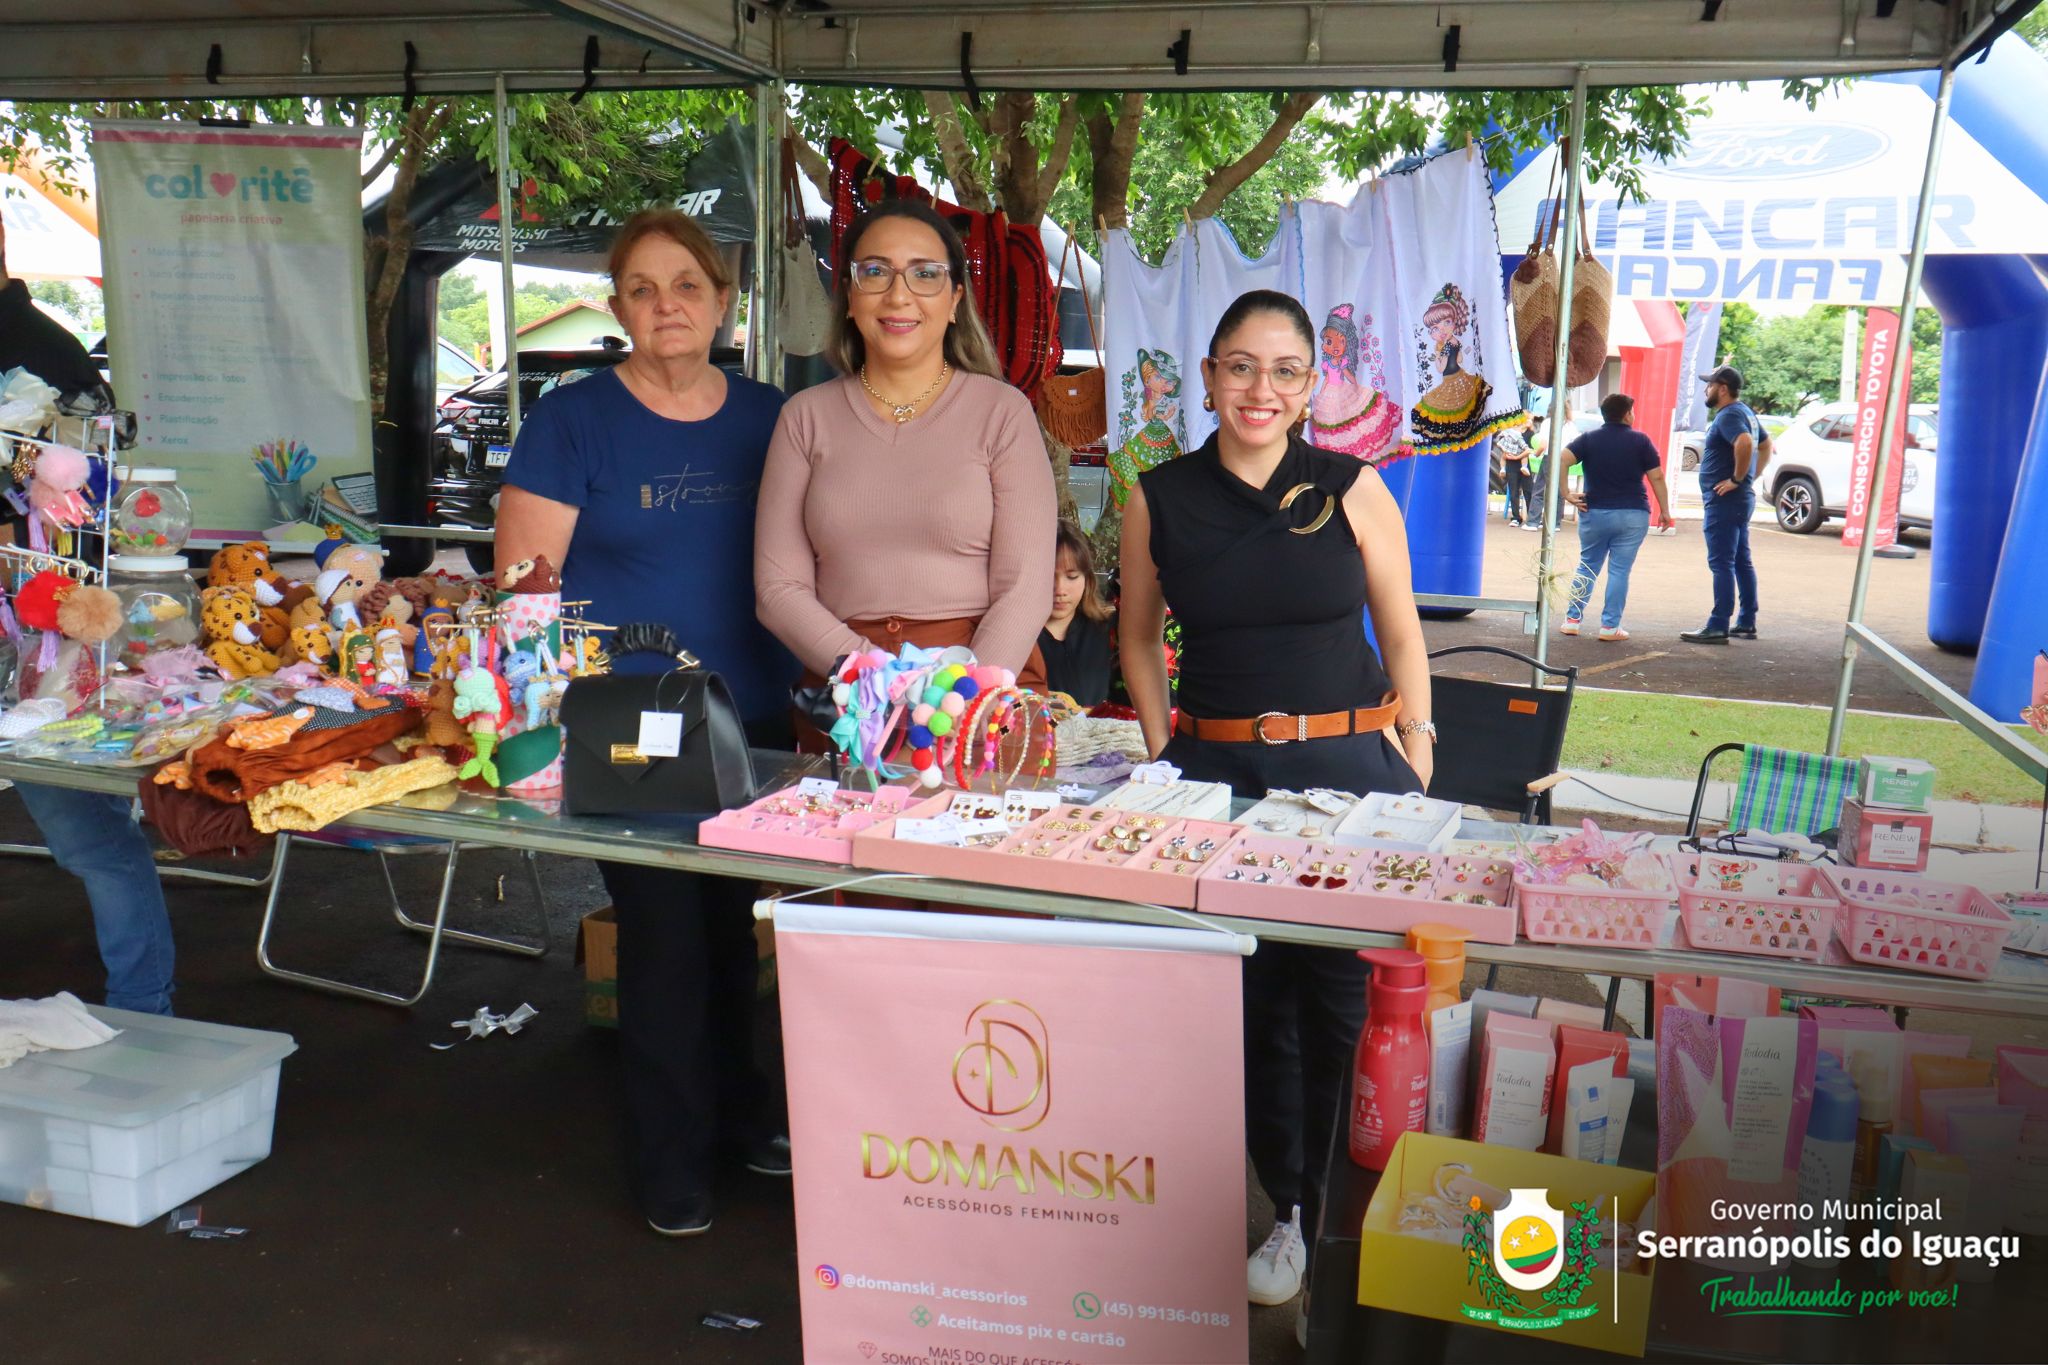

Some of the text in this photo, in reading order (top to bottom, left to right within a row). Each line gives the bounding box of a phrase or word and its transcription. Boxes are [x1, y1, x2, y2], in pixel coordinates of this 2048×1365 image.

[1676, 128, 1832, 168] Ford
[1534, 195, 1977, 251] FANCAR
[1852, 407, 1877, 517] CONSÓRCIO
[1865, 329, 1889, 403] TOYOTA
[160, 435, 189, 445] Xerox
[1882, 777, 1920, 787] RENEW
[1874, 832, 1916, 843] RENEW
[861, 1132, 1155, 1205] DOMANSKI
[904, 1195, 1120, 1225] ACESSÓRIOS FEMININOS
[842, 1273, 1028, 1306] @domanski_acessorios
[1104, 1301, 1231, 1328] (45) 99136-0188
[937, 1313, 1126, 1348] Aceitamos pix e cartão
[881, 1352, 930, 1365] SOMOS
[928, 1346, 961, 1360] MAIS
[965, 1350, 986, 1363] DO
[989, 1353, 1018, 1365] QUE
